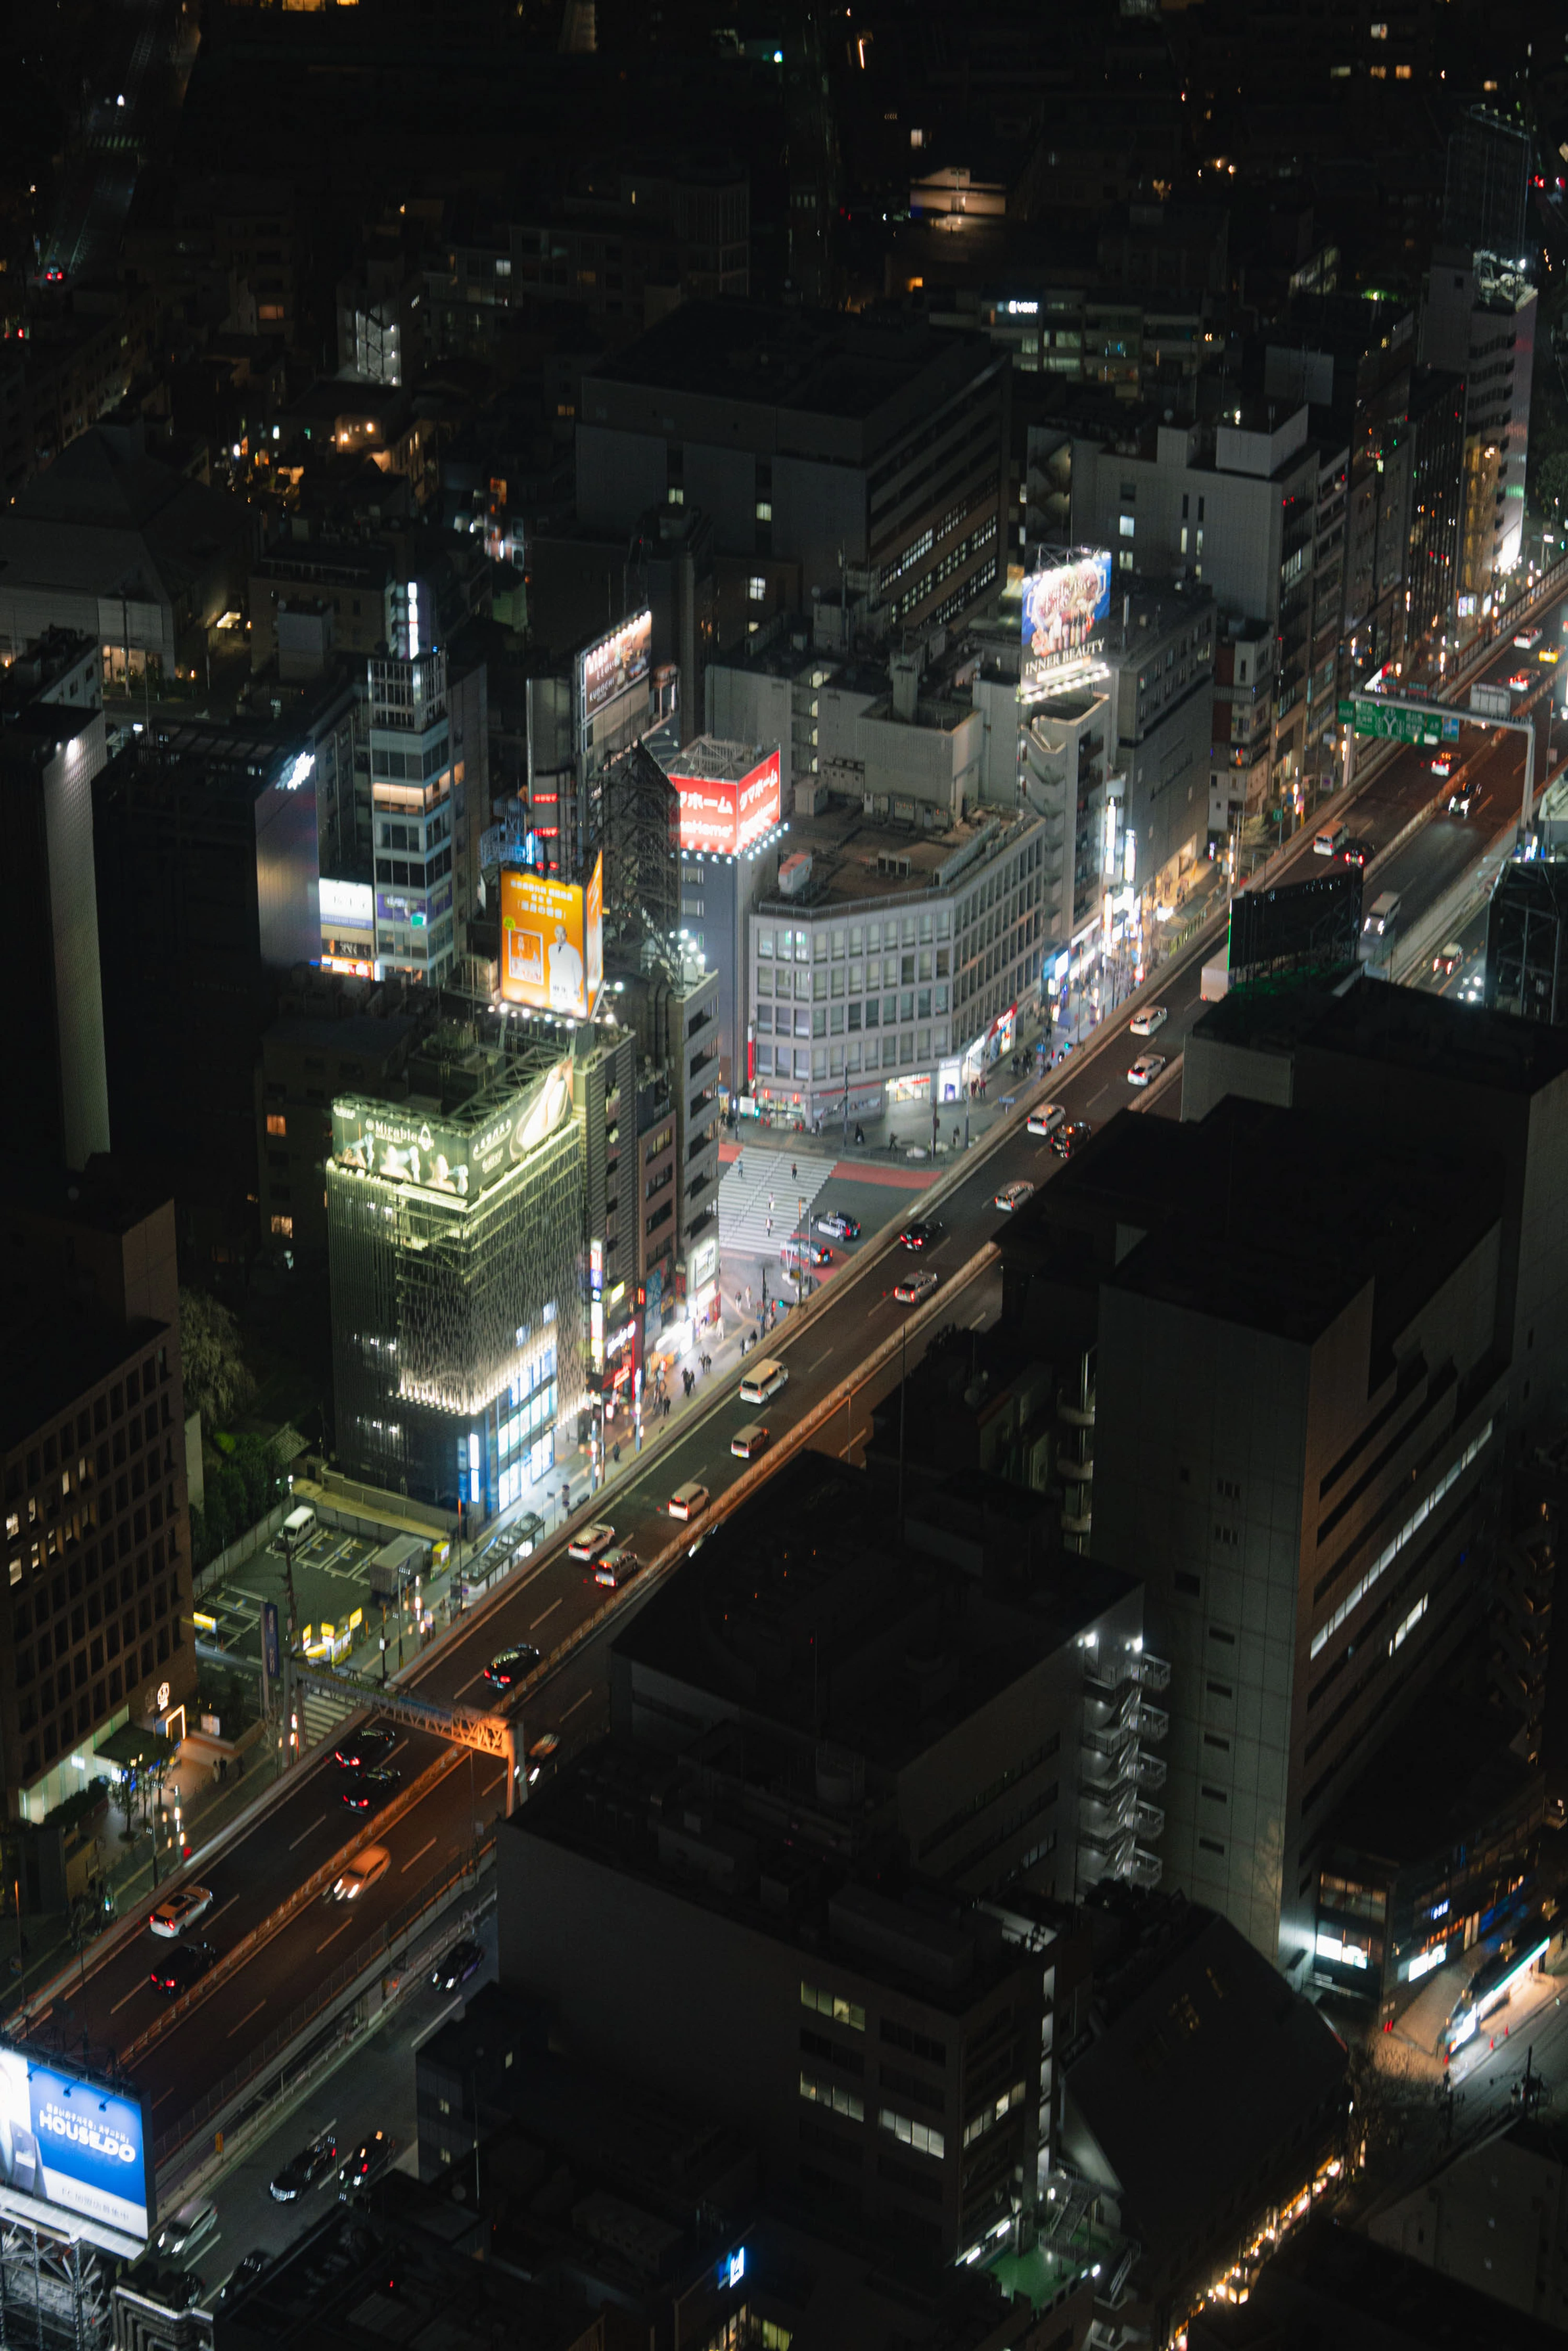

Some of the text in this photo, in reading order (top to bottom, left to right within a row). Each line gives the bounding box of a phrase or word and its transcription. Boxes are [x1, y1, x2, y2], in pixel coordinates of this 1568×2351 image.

[1025, 637, 1105, 676] INNER BEAUTY
[740, 769, 778, 812] タマホーム
